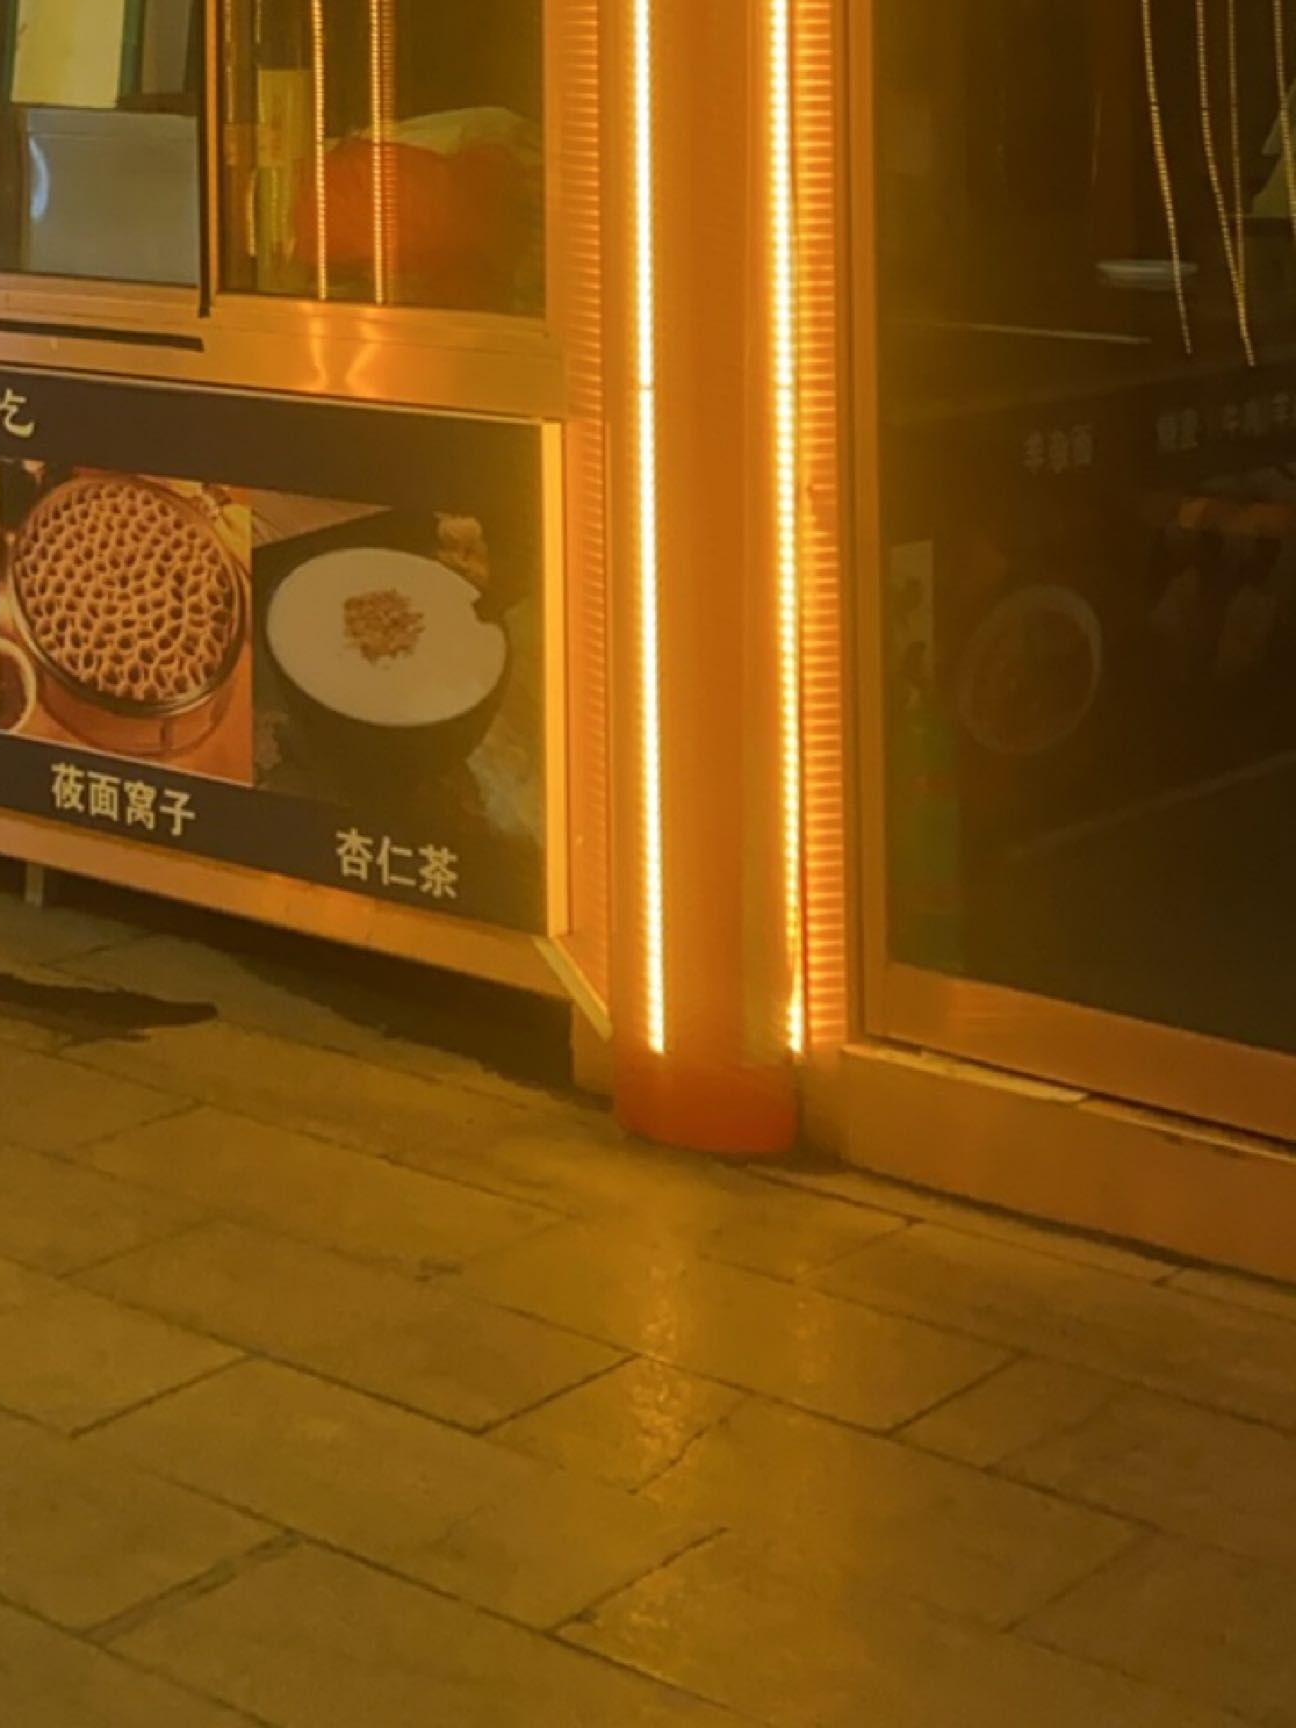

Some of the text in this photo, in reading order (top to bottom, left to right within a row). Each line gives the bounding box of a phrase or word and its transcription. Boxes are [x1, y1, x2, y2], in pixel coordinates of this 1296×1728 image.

[50, 762, 196, 837] 莜面窝子
[336, 828, 458, 899] 杏仁茶
